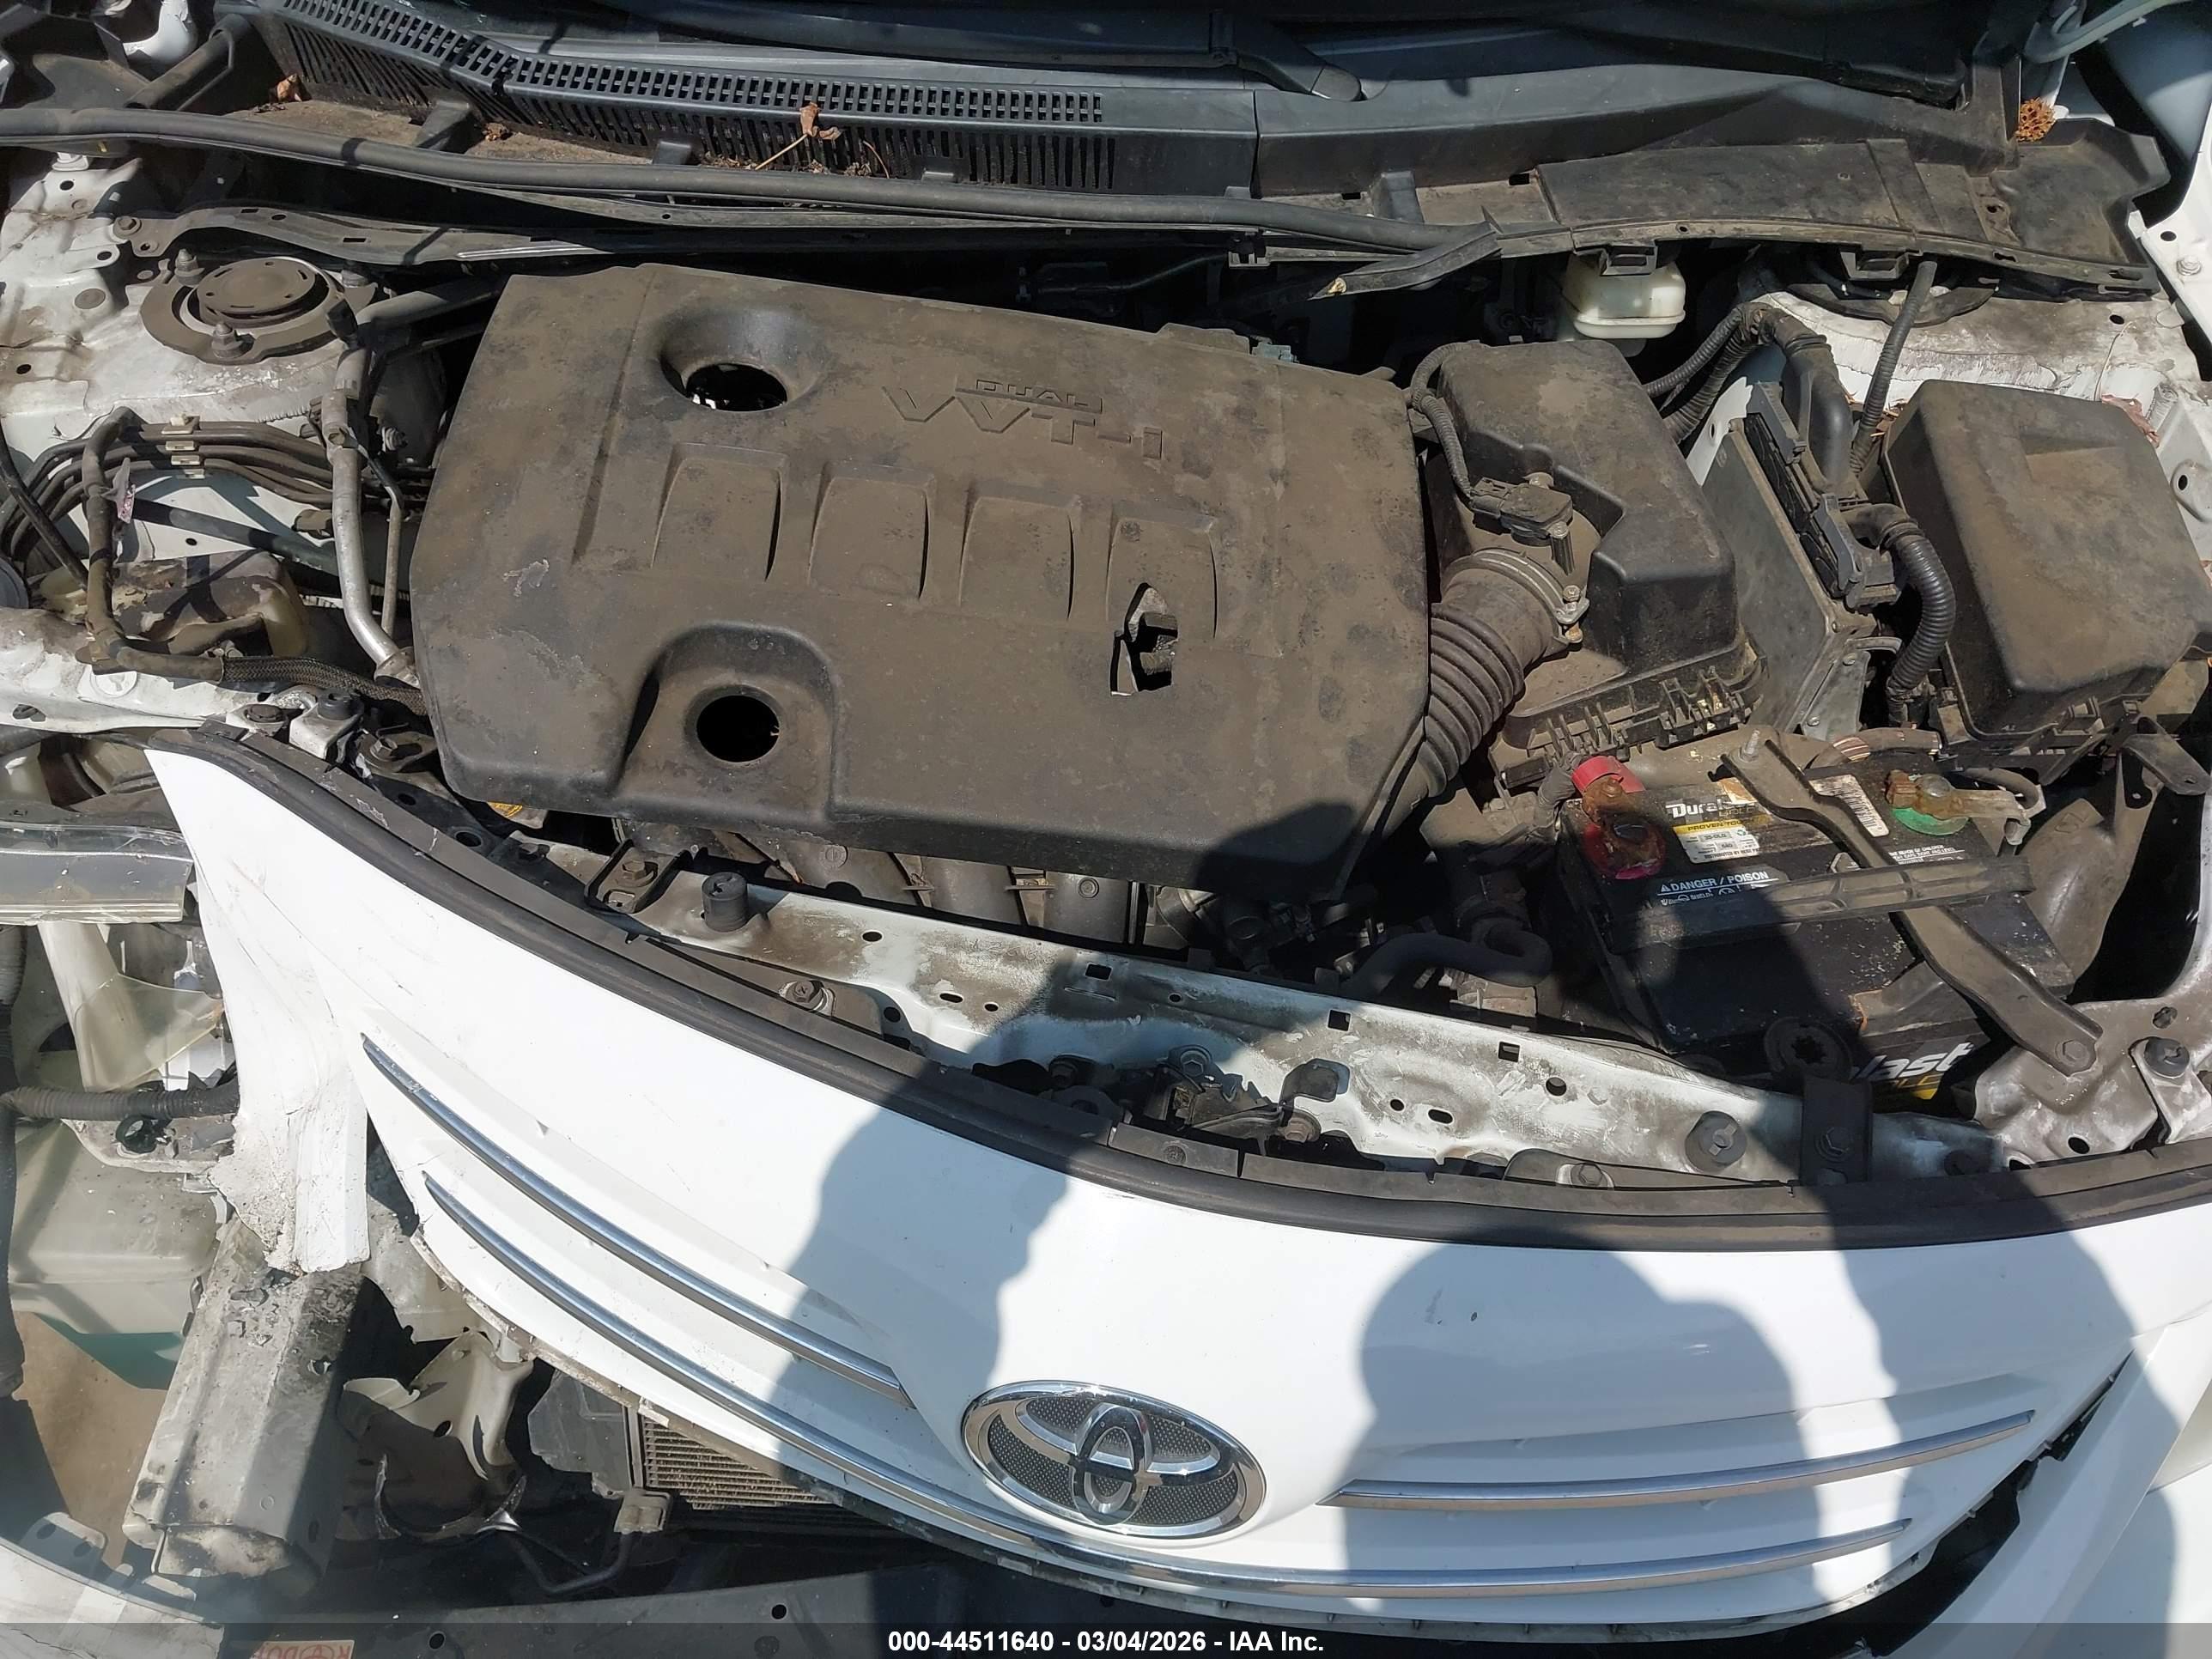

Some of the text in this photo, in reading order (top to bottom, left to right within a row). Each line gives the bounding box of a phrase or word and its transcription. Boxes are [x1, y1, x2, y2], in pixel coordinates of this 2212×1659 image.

[976, 379, 1091, 407] DUAL
[1687, 821, 1723, 832] PROVEN
[1670, 877, 1717, 891] DANGER
[1729, 871, 1770, 885] POISON
